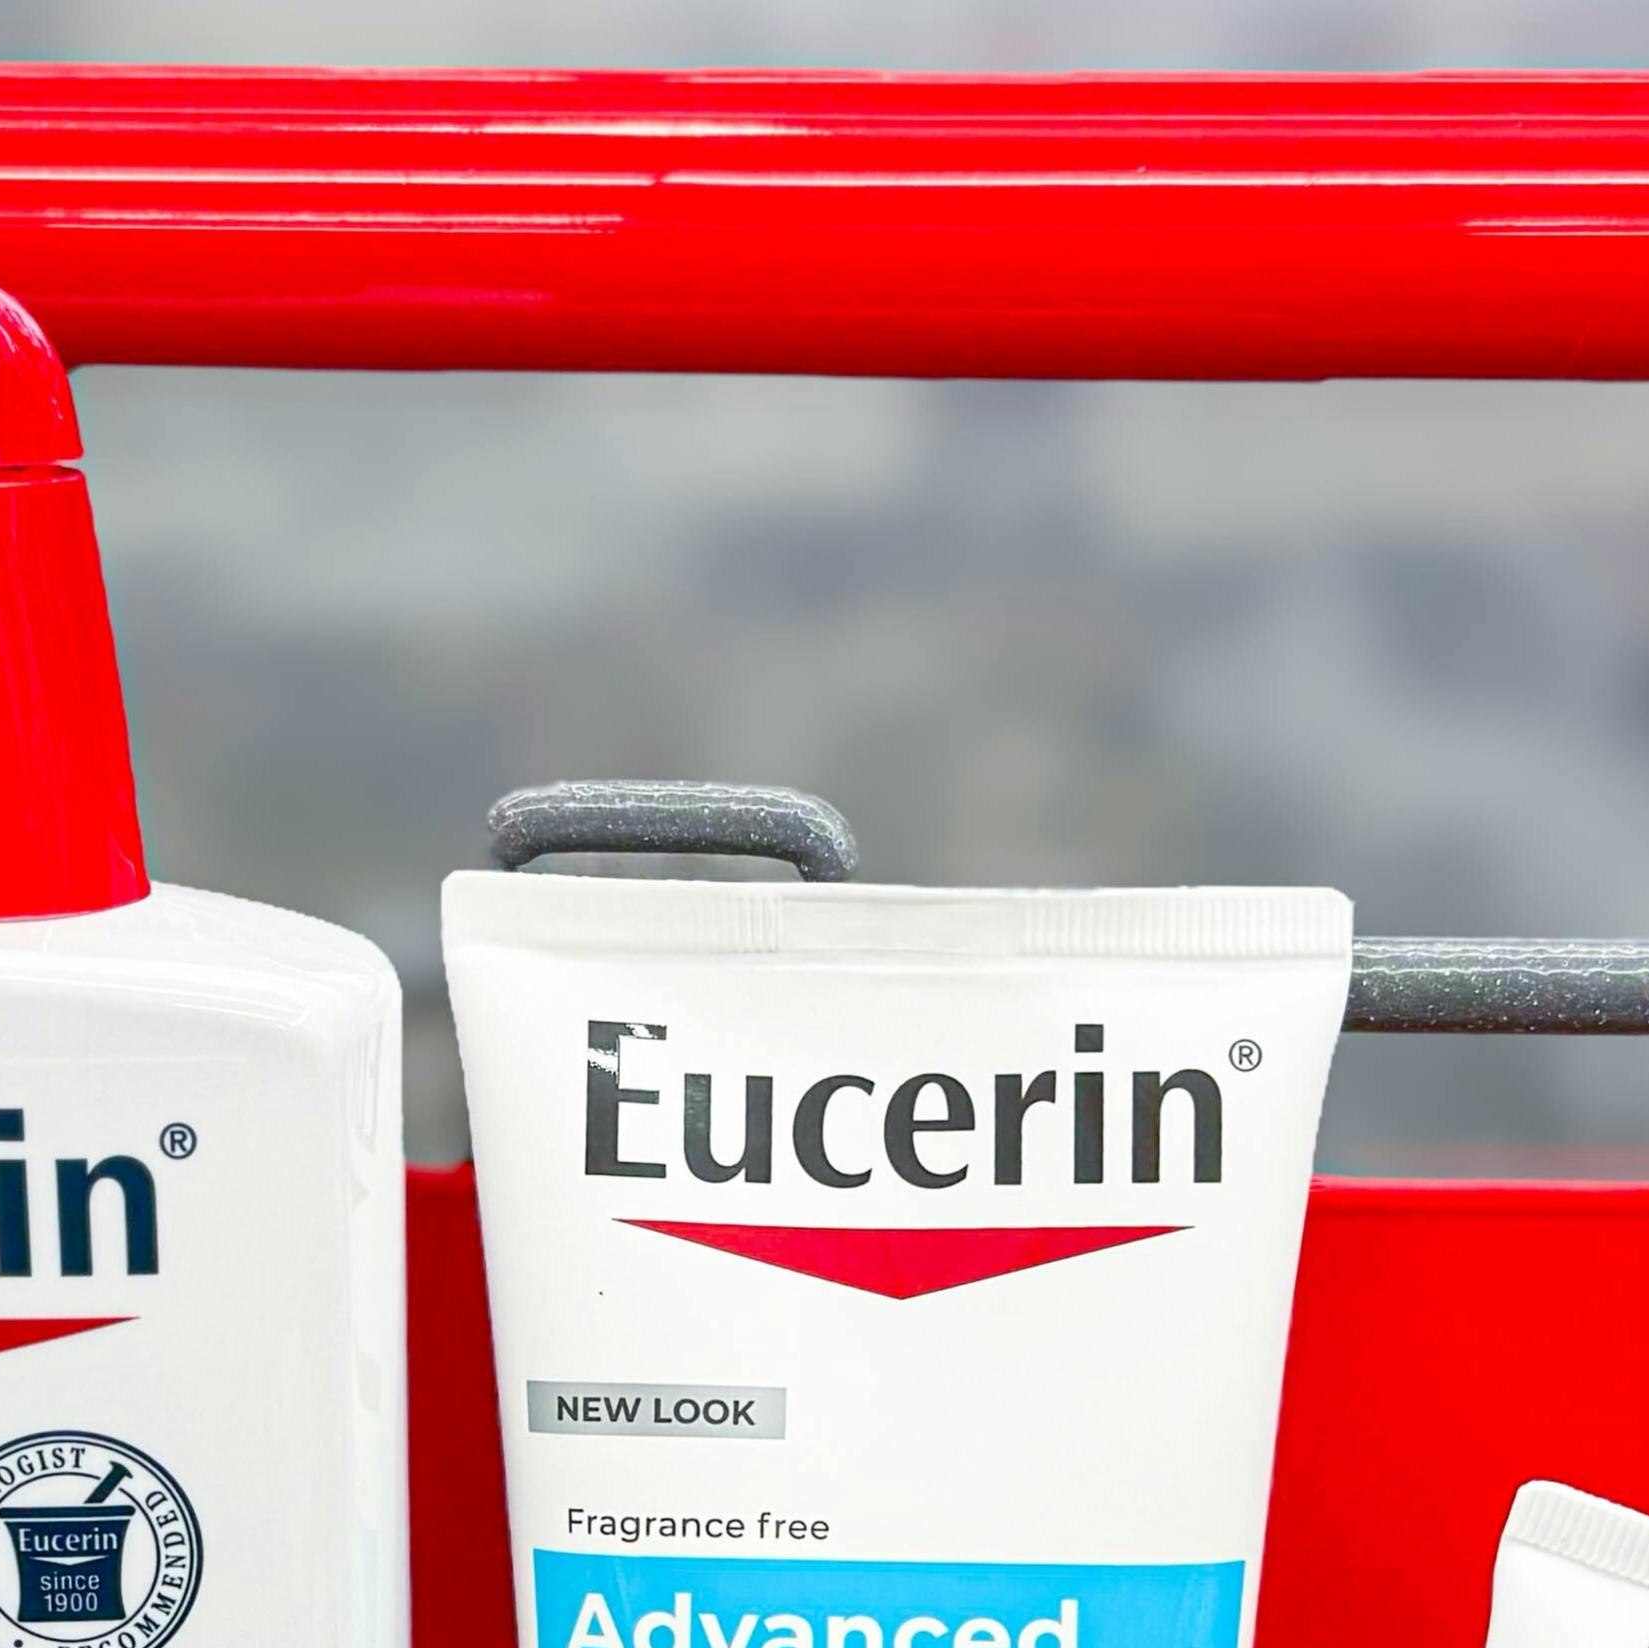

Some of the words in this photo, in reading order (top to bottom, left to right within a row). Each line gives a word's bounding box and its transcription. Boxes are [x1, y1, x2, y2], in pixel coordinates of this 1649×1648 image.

[555, 1395, 642, 1426] NEW
[653, 1397, 757, 1428] LOOK
[566, 1507, 746, 1543] Fragrance
[757, 1511, 831, 1541] free
[17, 1526, 120, 1555] Eucerin
[38, 1570, 101, 1593] since
[43, 1592, 100, 1614] 1900
